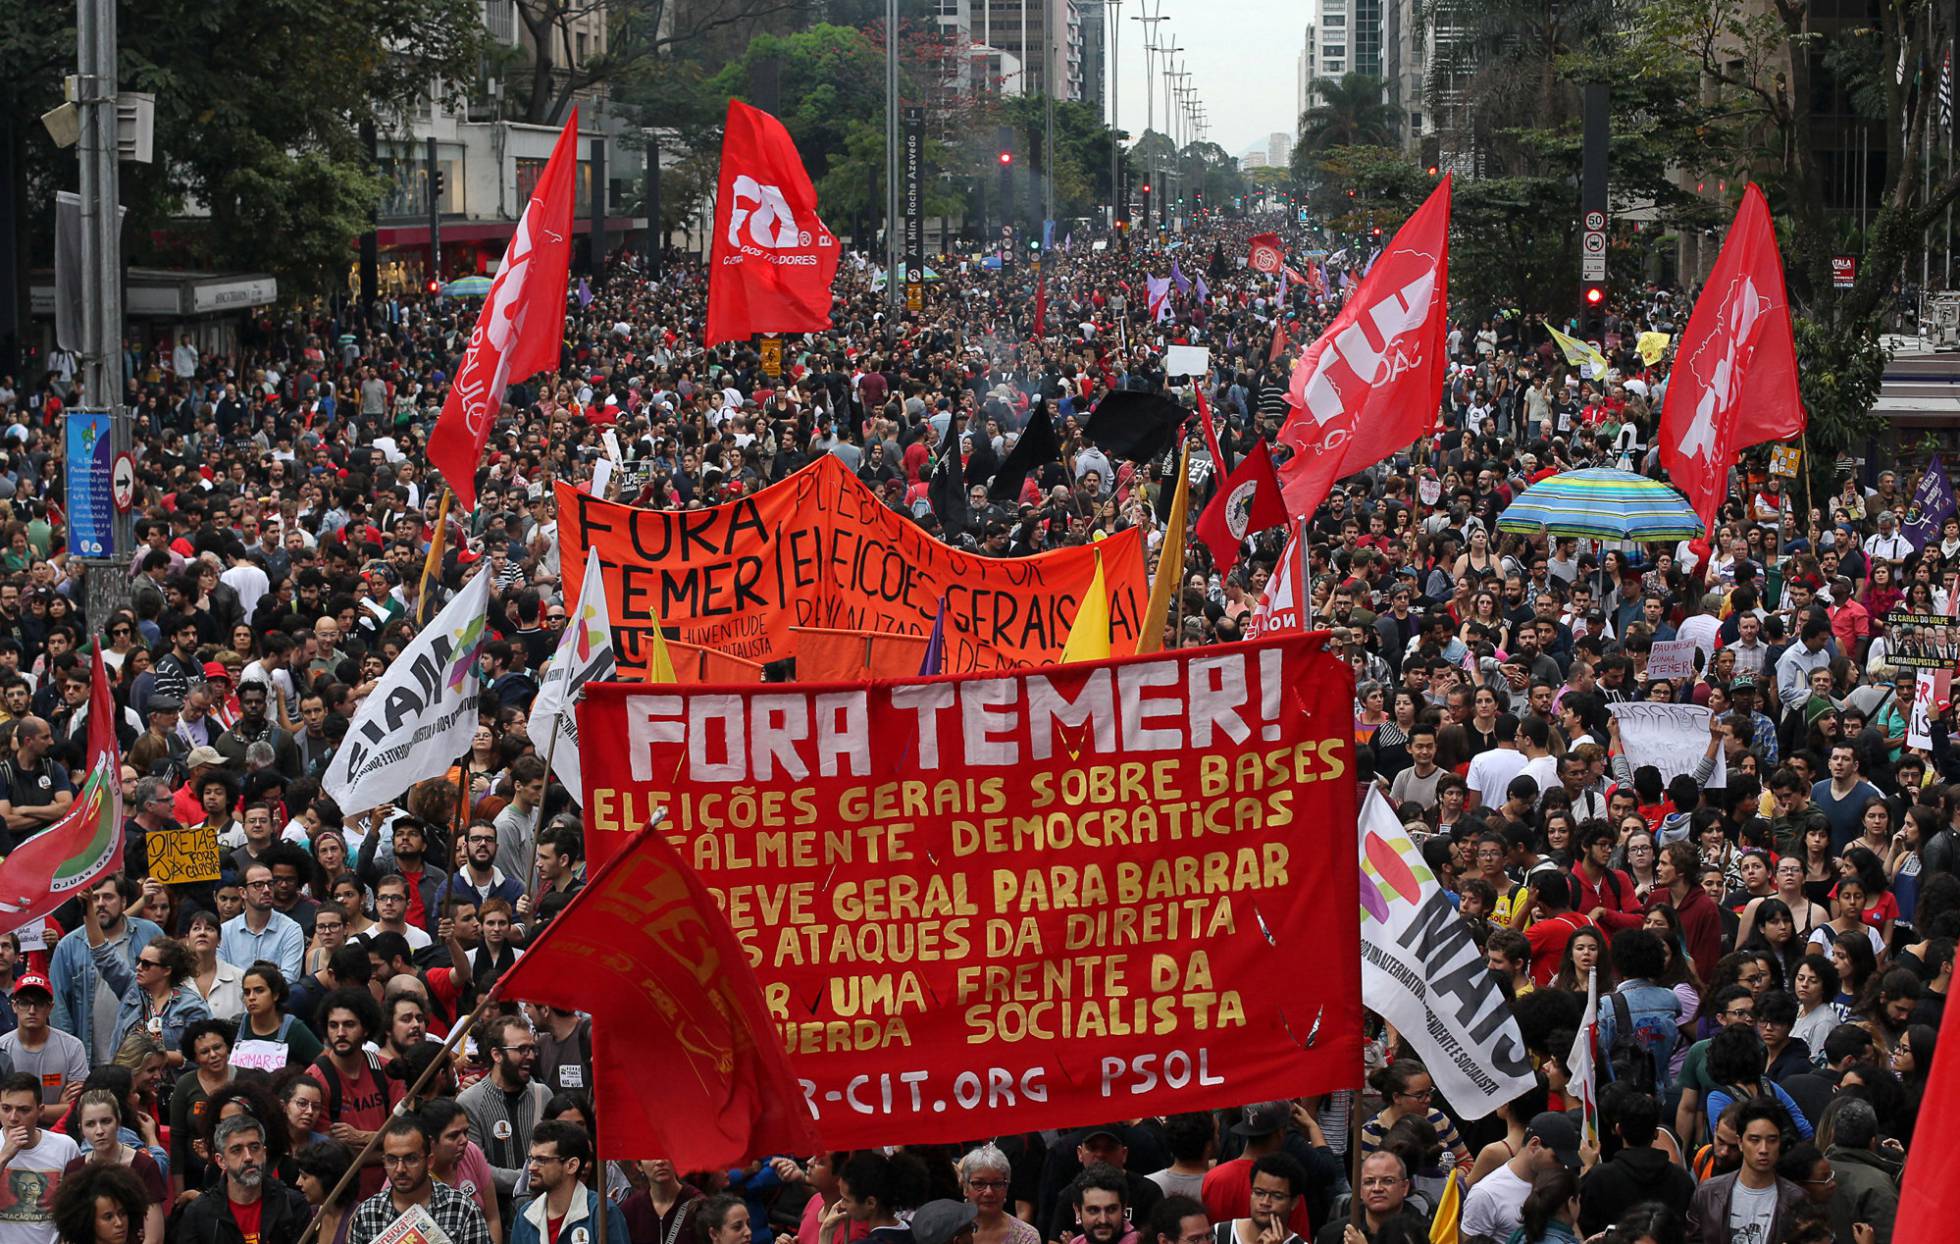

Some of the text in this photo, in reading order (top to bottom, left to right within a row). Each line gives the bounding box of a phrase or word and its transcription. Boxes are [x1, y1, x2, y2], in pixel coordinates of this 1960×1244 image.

[908, 135, 917, 180] Azevedo
[908, 182, 917, 216] Rocha
[1588, 215, 1602, 225] 50
[741, 244, 763, 256] DOS
[908, 219, 917, 241] Min.
[577, 493, 769, 562] FORA
[685, 613, 769, 645] JUVENTUDE
[945, 584, 1077, 650] GERAIS
[1888, 614, 1897, 622] AS
[1930, 617, 1949, 625] GOLPE
[716, 638, 773, 658] APITALISTA
[626, 648, 1283, 782] FORA TEMER!
[593, 739, 1345, 833] ELEIÇÕES GERAIS SOBRE BASES
[147, 828, 218, 857] DIRETAS
[832, 869, 979, 921] GERAL
[993, 864, 1109, 914] PARA
[1117, 842, 1290, 904] BARRAR
[736, 895, 1236, 969] S ATAQUES DA DIREITA
[830, 970, 928, 1017] UMA
[957, 954, 1129, 1006] FRENTE
[1151, 950, 1213, 993] DA
[1396, 887, 1534, 1078] MAIS
[777, 990, 1247, 1055] UERDA SOCIALISTA
[1381, 953, 1427, 1002] ALTERNATIVA
[1454, 1052, 1501, 1097] SOCIALISTA
[353, 1095, 384, 1112] MAIS
[797, 1048, 1225, 1121] R-CIT.ORG PSOL
[463, 1185, 474, 1196] 50
